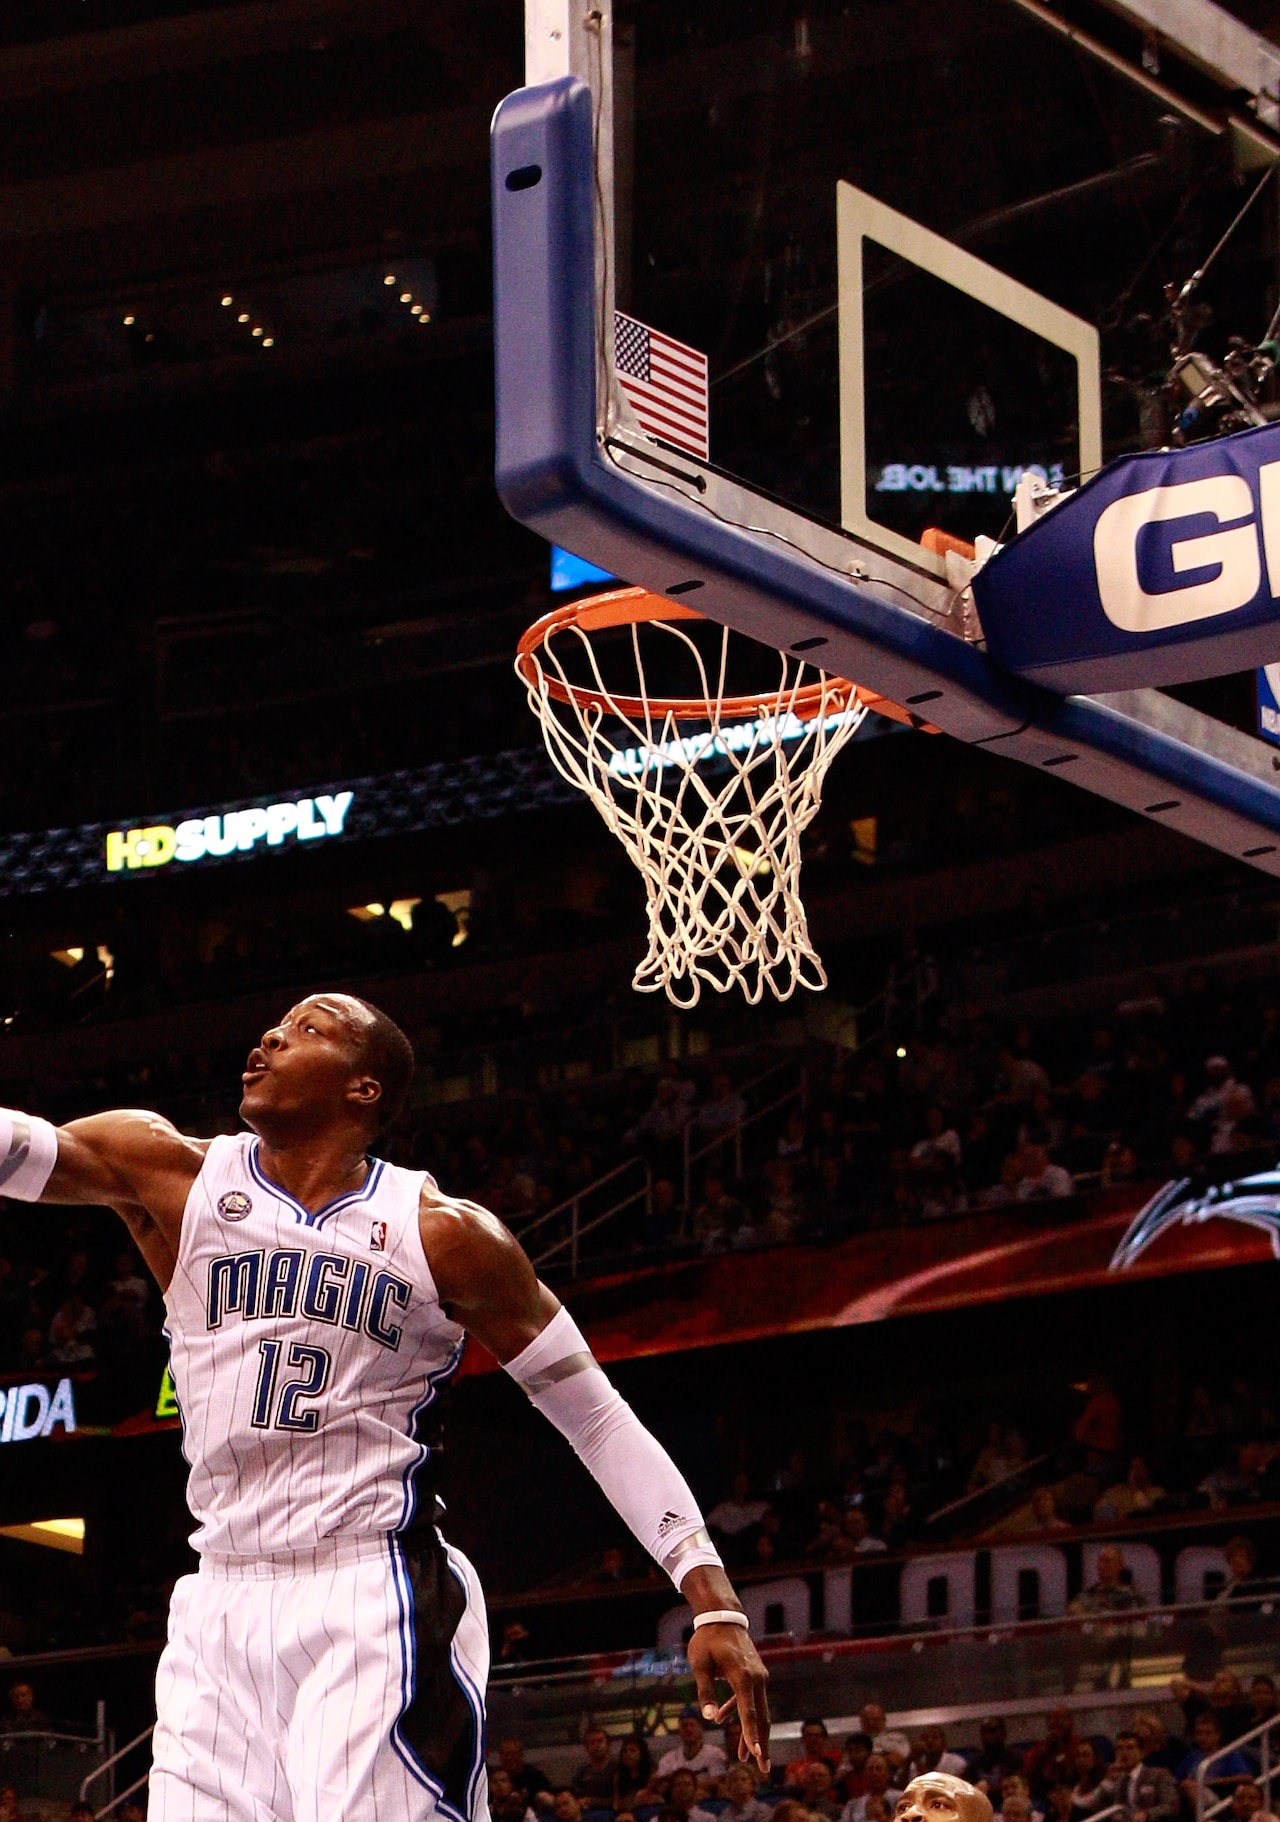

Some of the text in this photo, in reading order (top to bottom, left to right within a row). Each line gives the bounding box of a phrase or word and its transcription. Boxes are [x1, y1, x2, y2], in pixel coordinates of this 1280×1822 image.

[1093, 461, 1280, 633] G
[206, 1248, 413, 1350] MAGIC
[251, 1339, 332, 1432] 12
